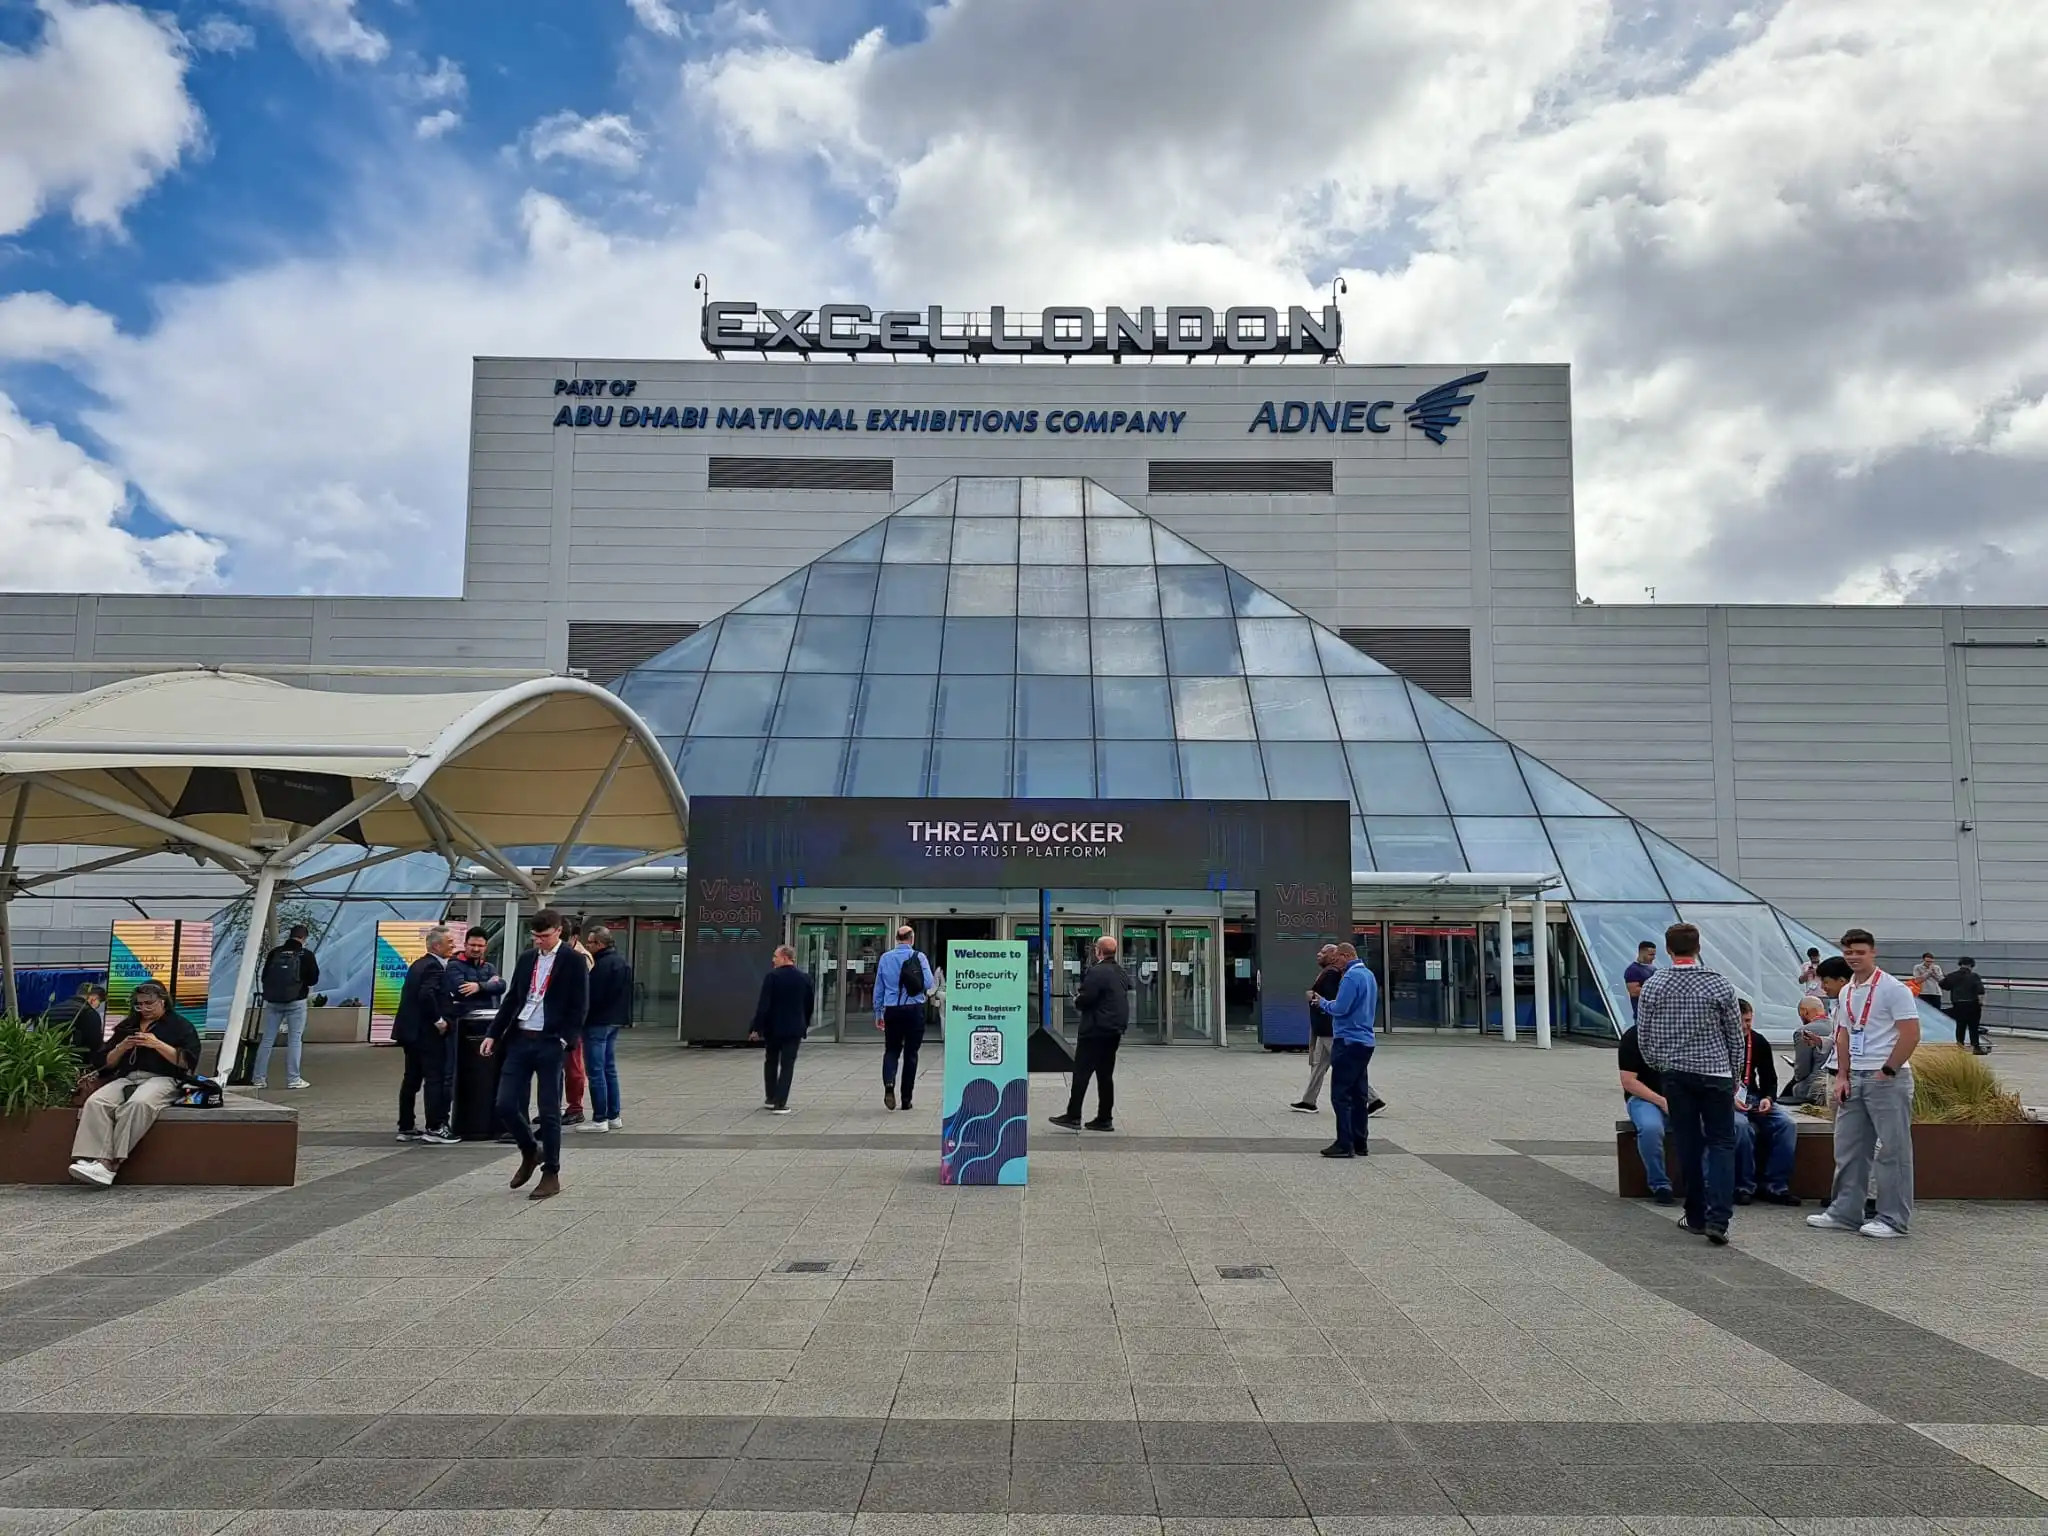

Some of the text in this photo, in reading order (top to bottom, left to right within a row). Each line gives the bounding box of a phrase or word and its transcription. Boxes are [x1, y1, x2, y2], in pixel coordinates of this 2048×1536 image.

[554, 379, 637, 396] PART OF
[553, 405, 1187, 433] ABU DHABI NATIONAL EXHIBITIONS COMPANY
[1248, 401, 1394, 433] ADNEC
[907, 821, 1124, 843] THREATLOCKER
[924, 845, 1107, 858] ZERO TRUST PLATFORM
[700, 878, 762, 902] Visit
[1275, 882, 1339, 906] Visit
[698, 905, 761, 923] booth
[1276, 909, 1339, 929] booth
[953, 949, 1022, 959] Welcome to
[955, 980, 992, 992] Europe
[984, 1005, 1021, 1014] Register?
